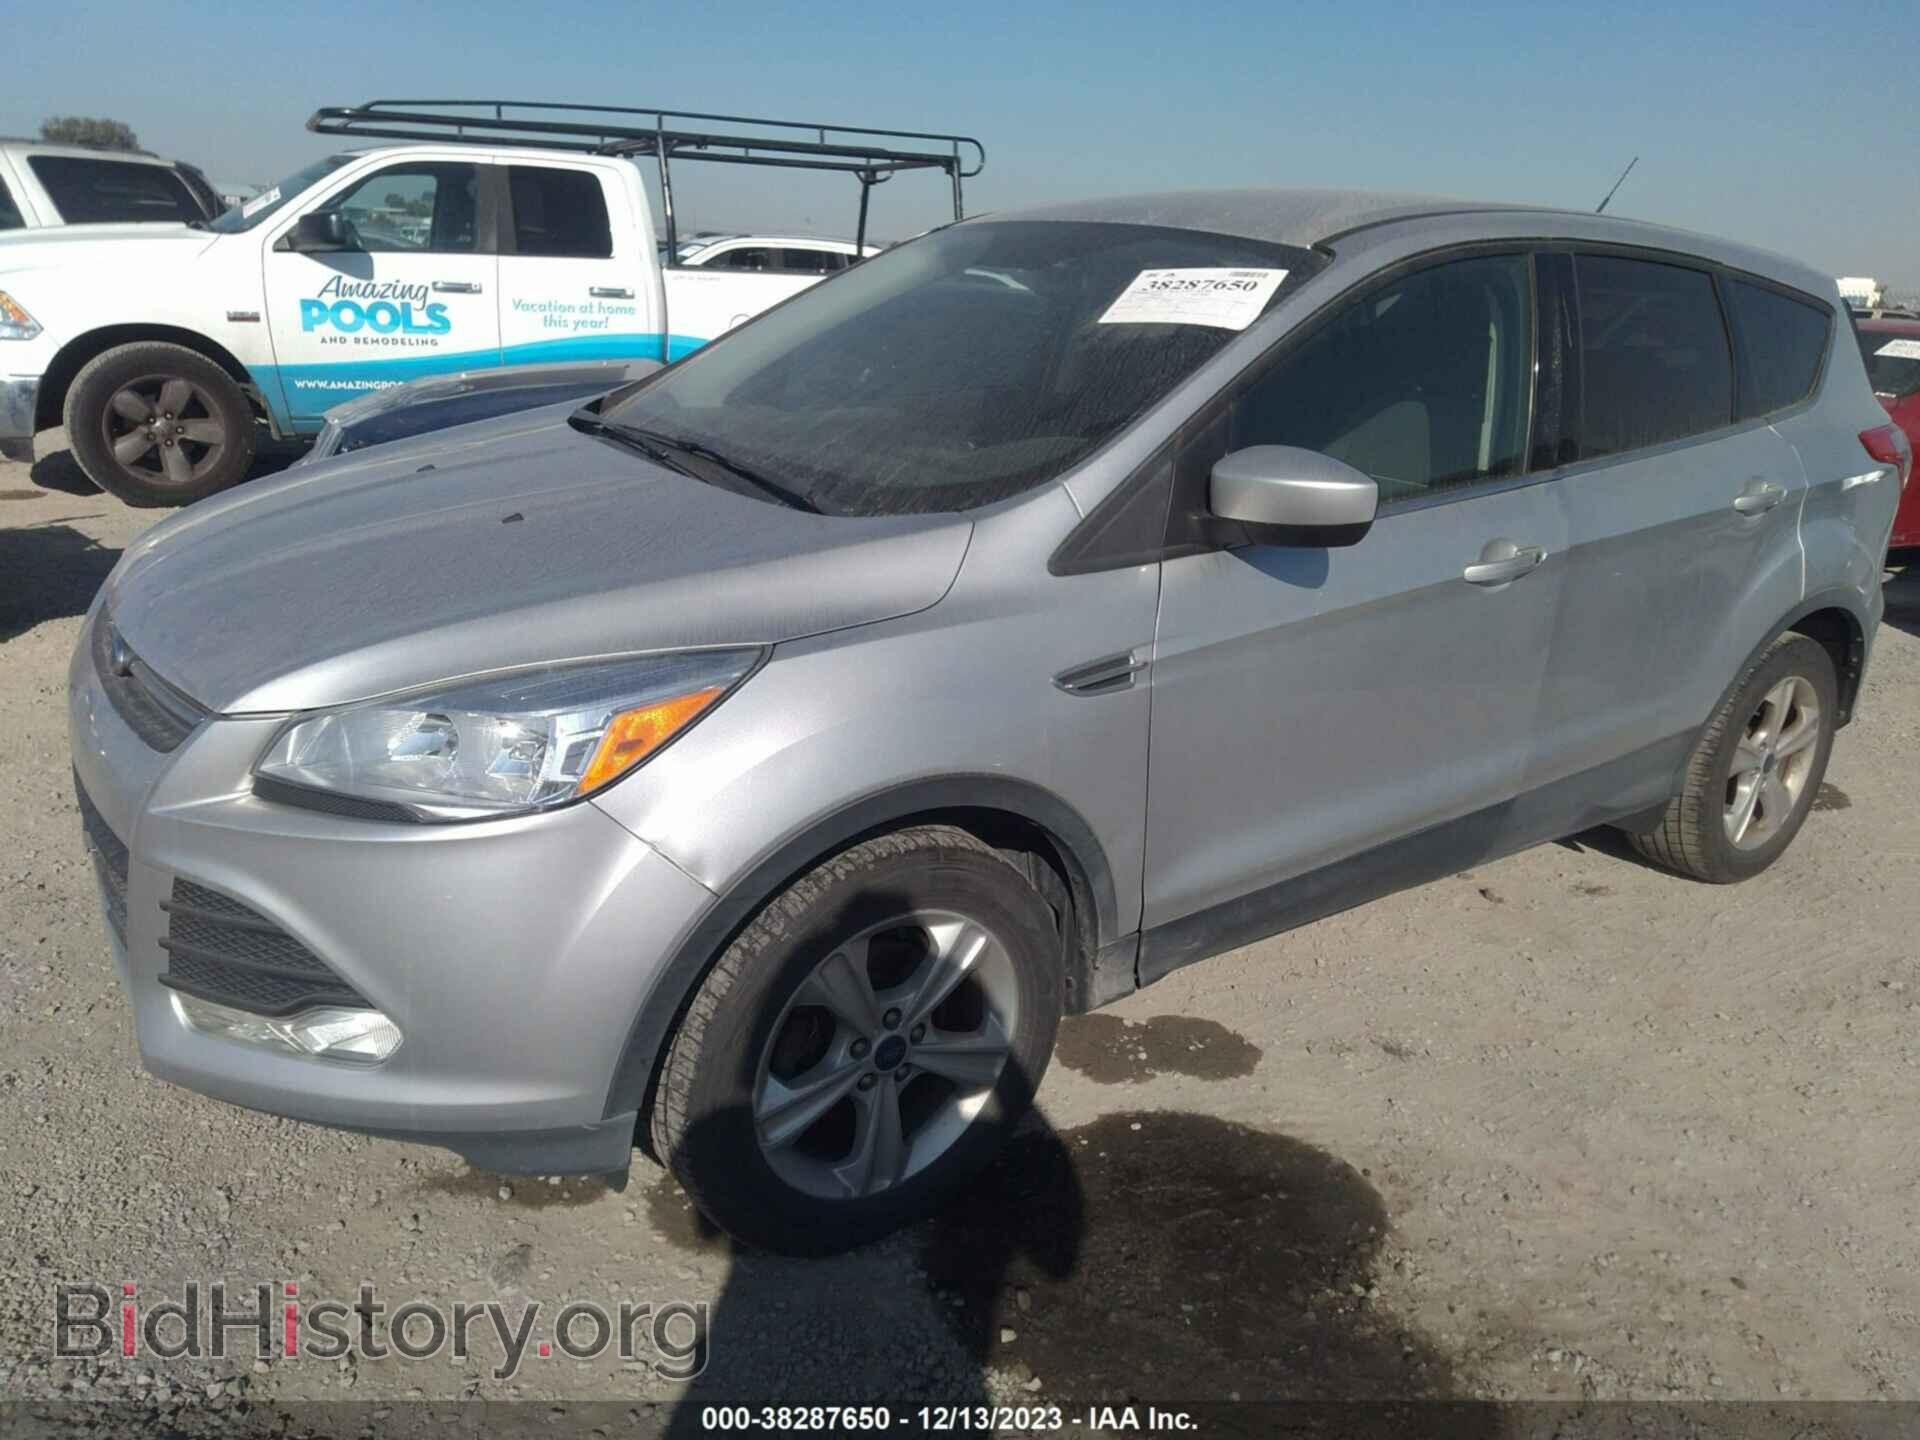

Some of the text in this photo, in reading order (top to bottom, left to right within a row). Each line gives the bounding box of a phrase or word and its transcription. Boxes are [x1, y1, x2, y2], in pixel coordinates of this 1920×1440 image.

[317, 275, 428, 312] Amazing
[1142, 279, 1258, 292] 38287650
[512, 298, 637, 316] Vacation at home
[299, 299, 451, 334] POOLS
[543, 315, 609, 332] this year!
[320, 336, 439, 347] AND REMODELING
